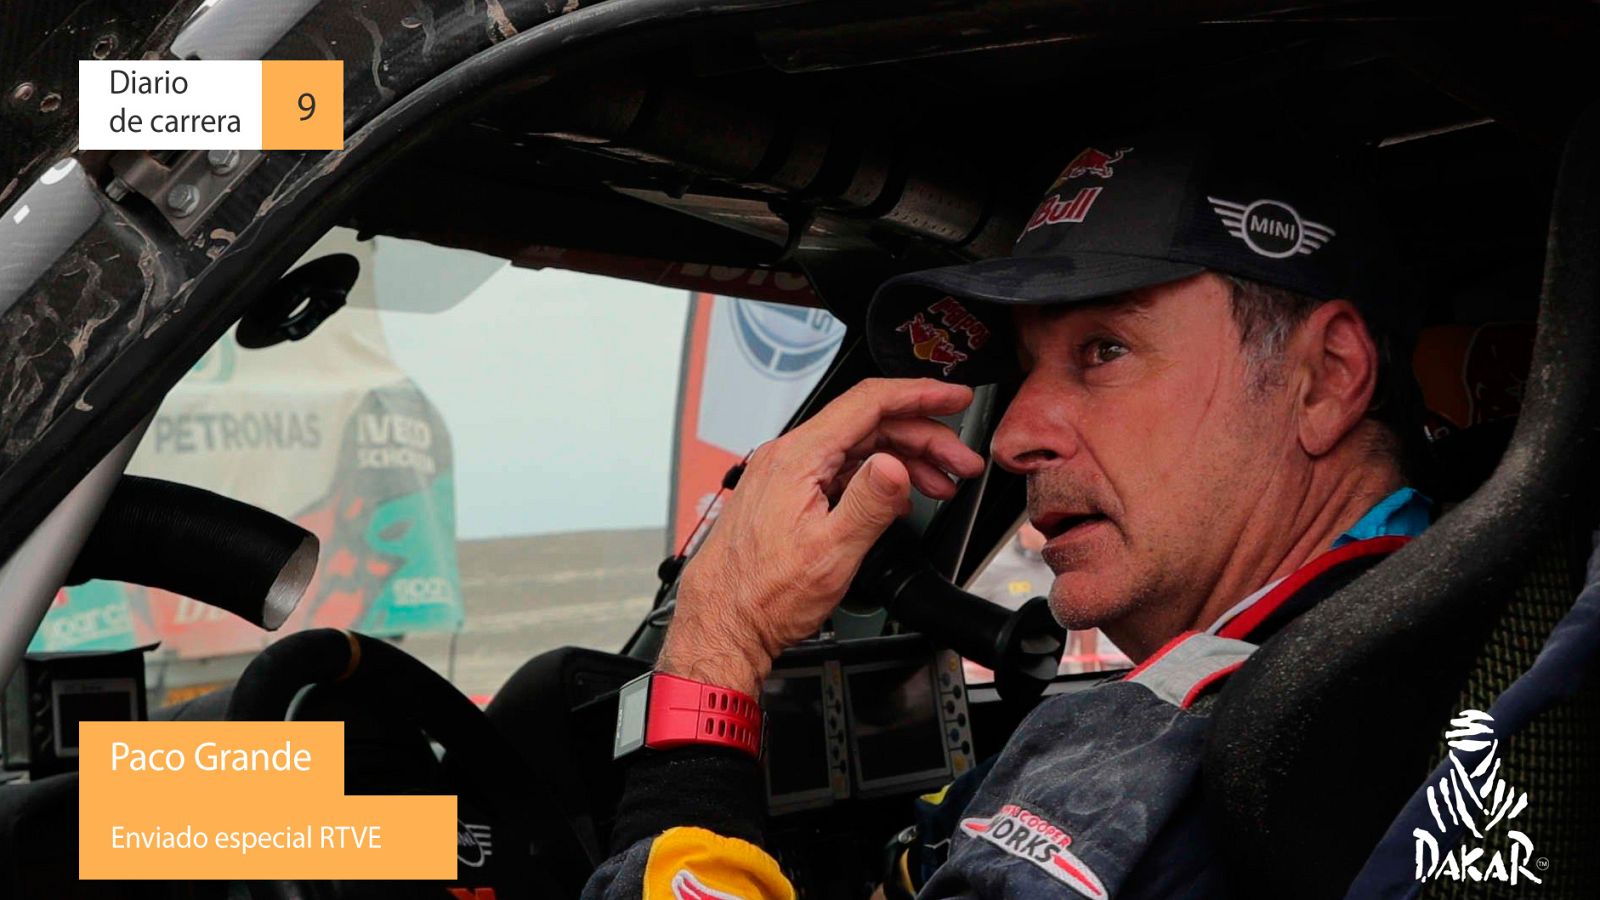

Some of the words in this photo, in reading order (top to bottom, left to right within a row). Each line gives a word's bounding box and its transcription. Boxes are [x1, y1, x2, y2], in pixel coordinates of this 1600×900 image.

[1249, 214, 1296, 241] MINI
[154, 411, 321, 455] PETRONAS
[1018, 810, 1071, 848] COOPER
